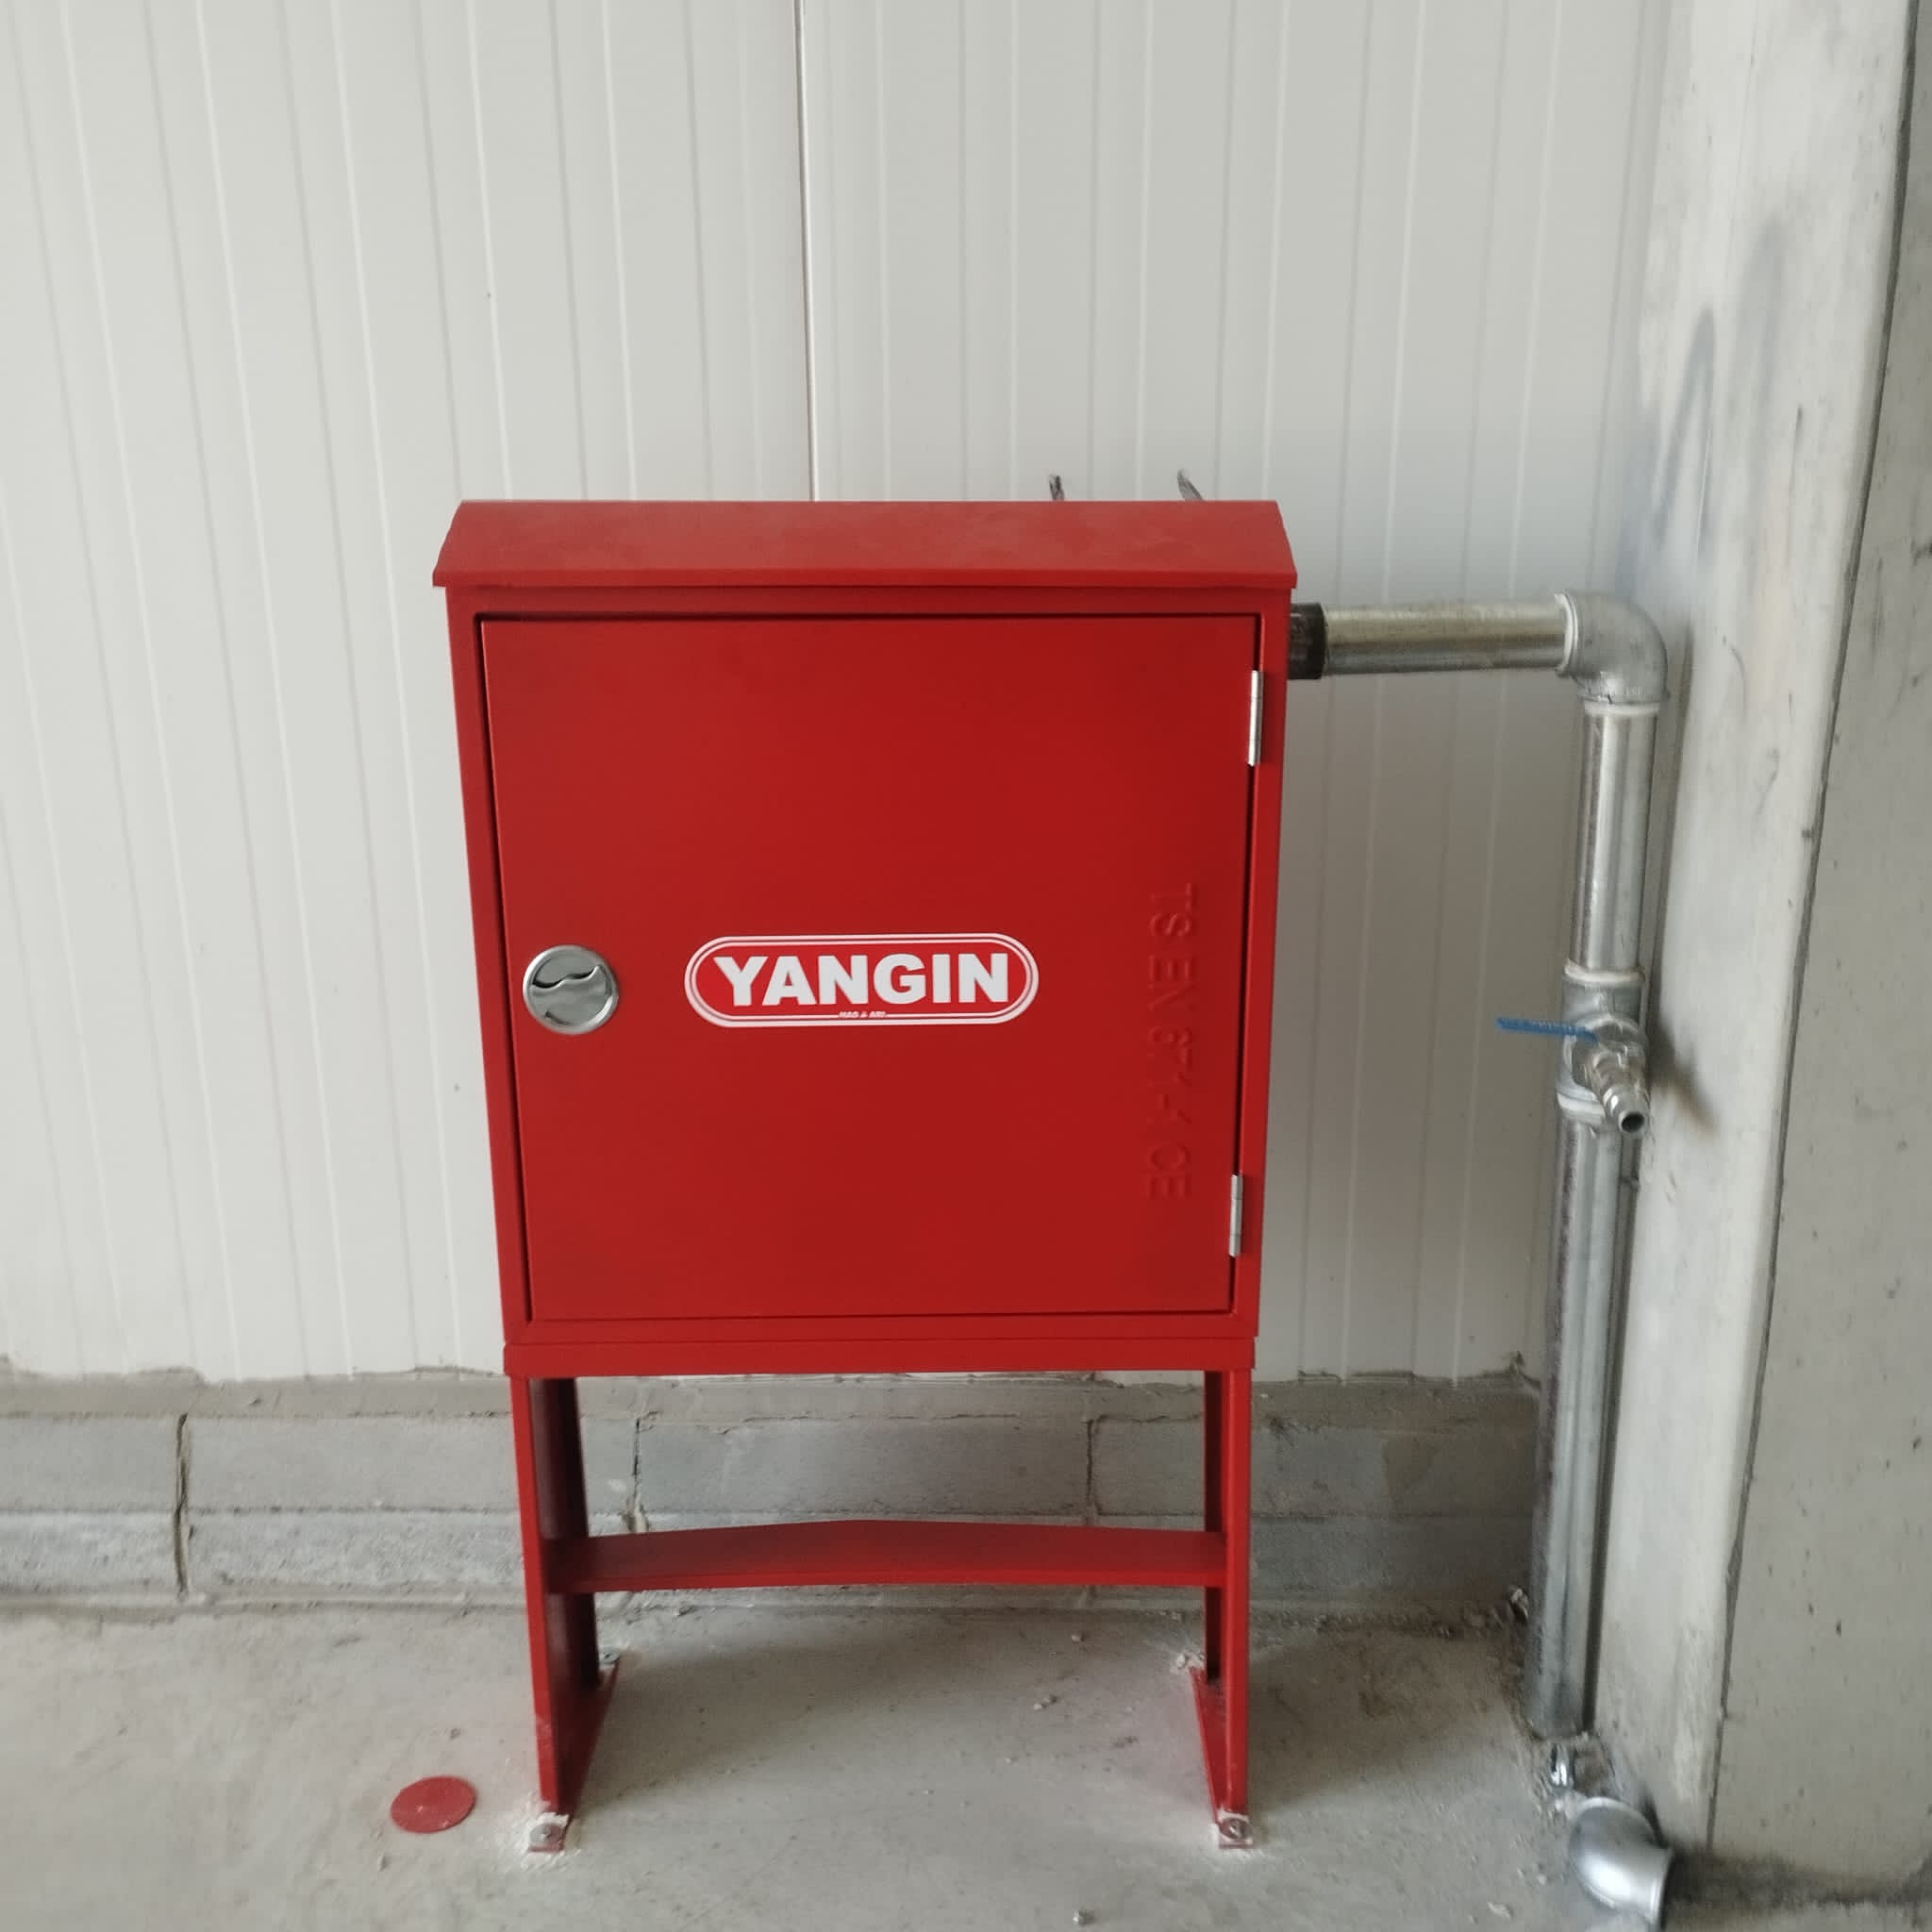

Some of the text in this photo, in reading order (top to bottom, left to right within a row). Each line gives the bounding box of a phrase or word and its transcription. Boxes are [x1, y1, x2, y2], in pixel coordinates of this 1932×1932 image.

[1149, 882, 1196, 937] TS
[713, 953, 1008, 1007] YANGIN
[1148, 953, 1196, 1012] EN
